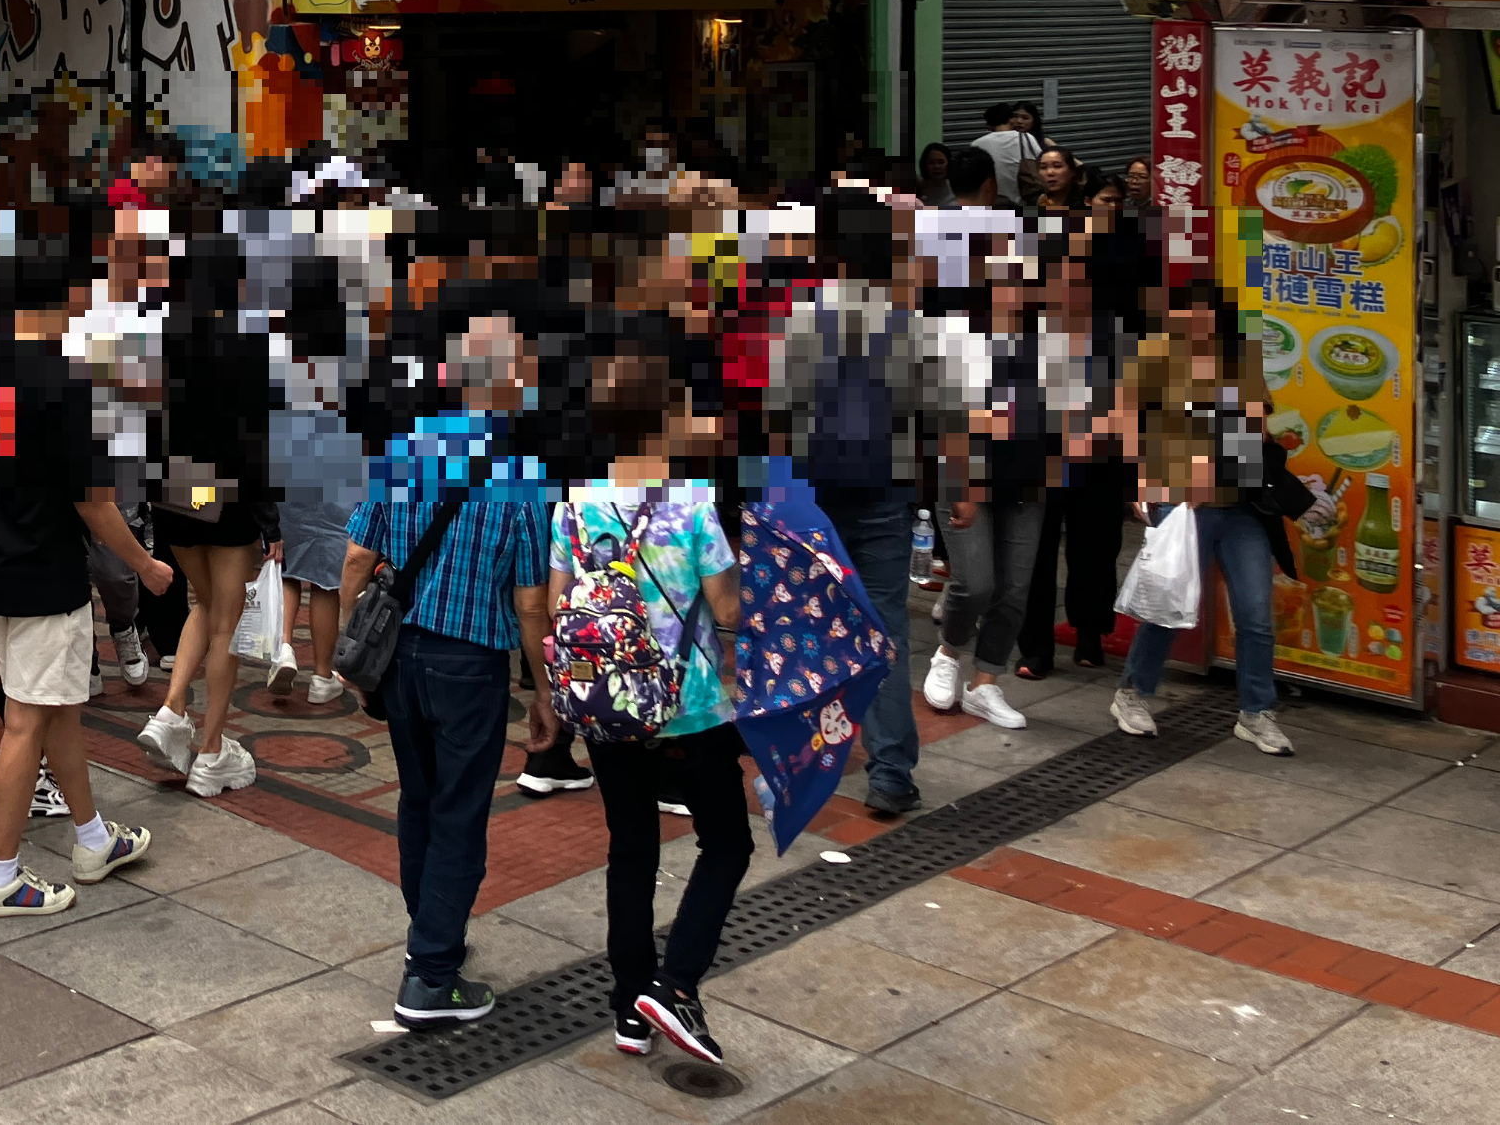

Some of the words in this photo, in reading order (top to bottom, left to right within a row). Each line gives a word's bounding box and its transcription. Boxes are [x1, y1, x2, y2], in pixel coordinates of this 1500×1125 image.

[1156, 33, 1203, 139] 貓山王
[1233, 48, 1387, 100] 莫義記
[1246, 95, 1289, 110] Mok
[1300, 98, 1334, 113] Yei
[1345, 100, 1381, 115] Kei
